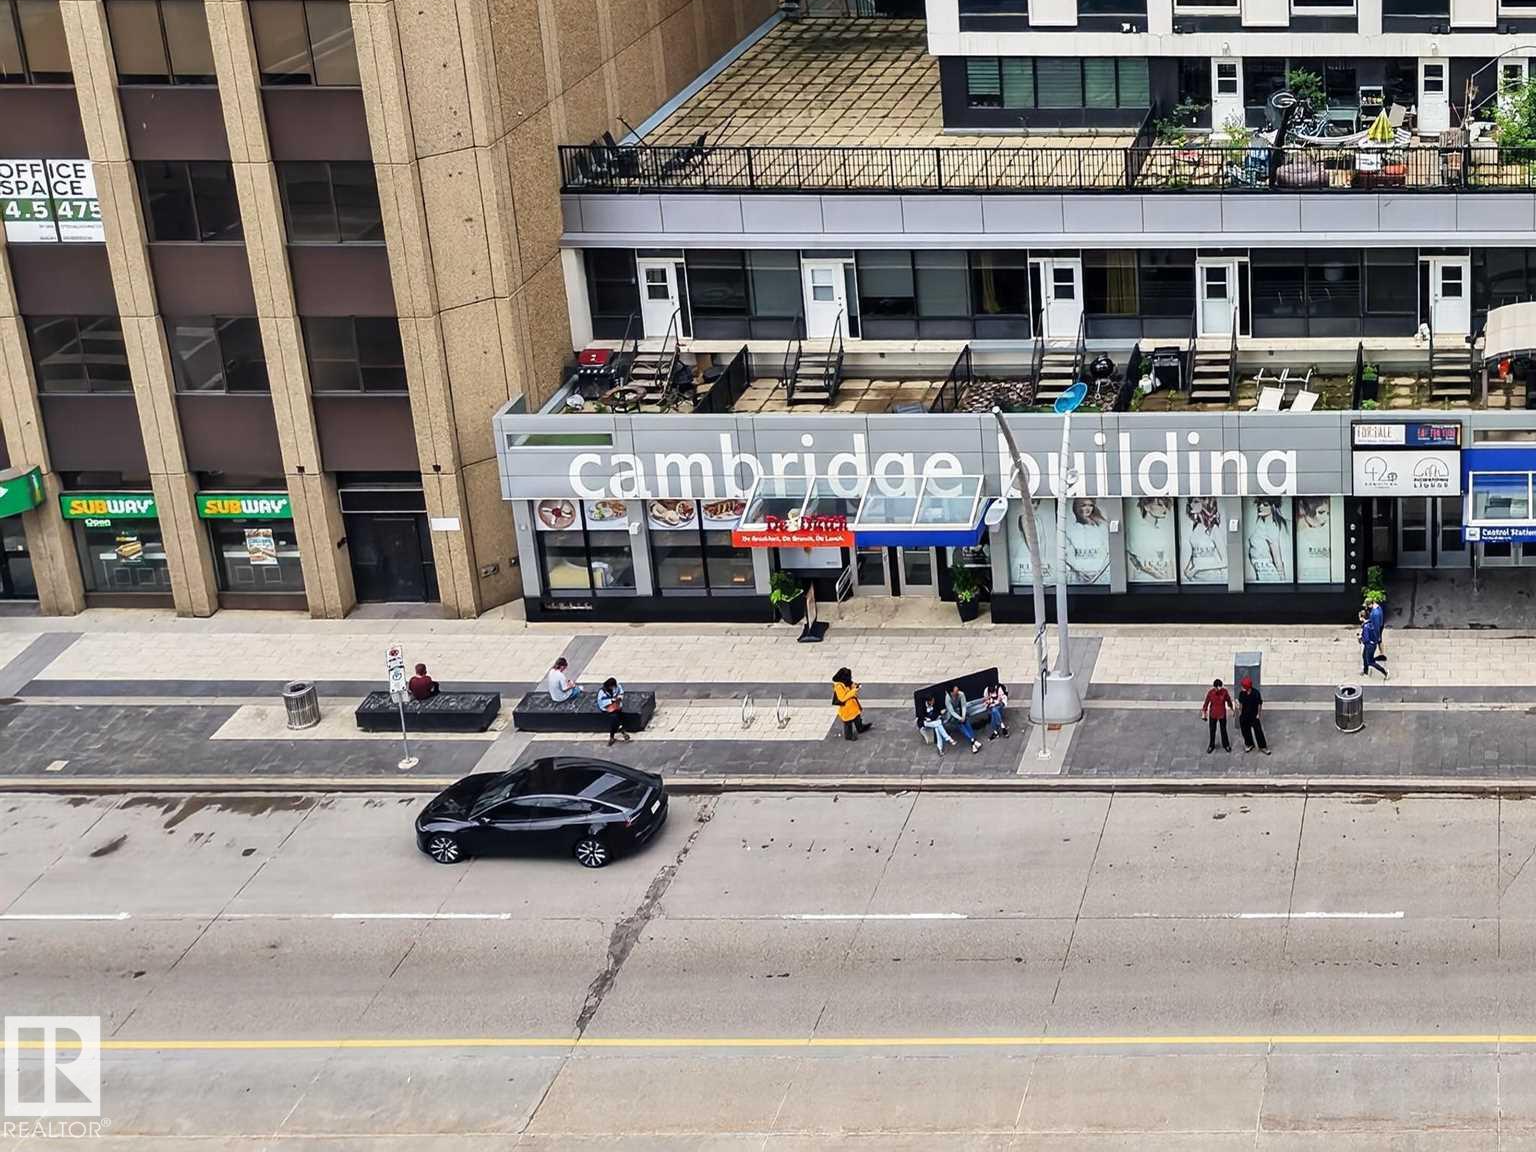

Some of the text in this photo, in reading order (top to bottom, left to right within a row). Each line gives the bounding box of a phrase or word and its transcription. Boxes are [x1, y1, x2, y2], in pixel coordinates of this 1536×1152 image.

[0, 163, 86, 178] OFFICE
[0, 180, 83, 195] SPACE
[568, 432, 1297, 499] cambridge building
